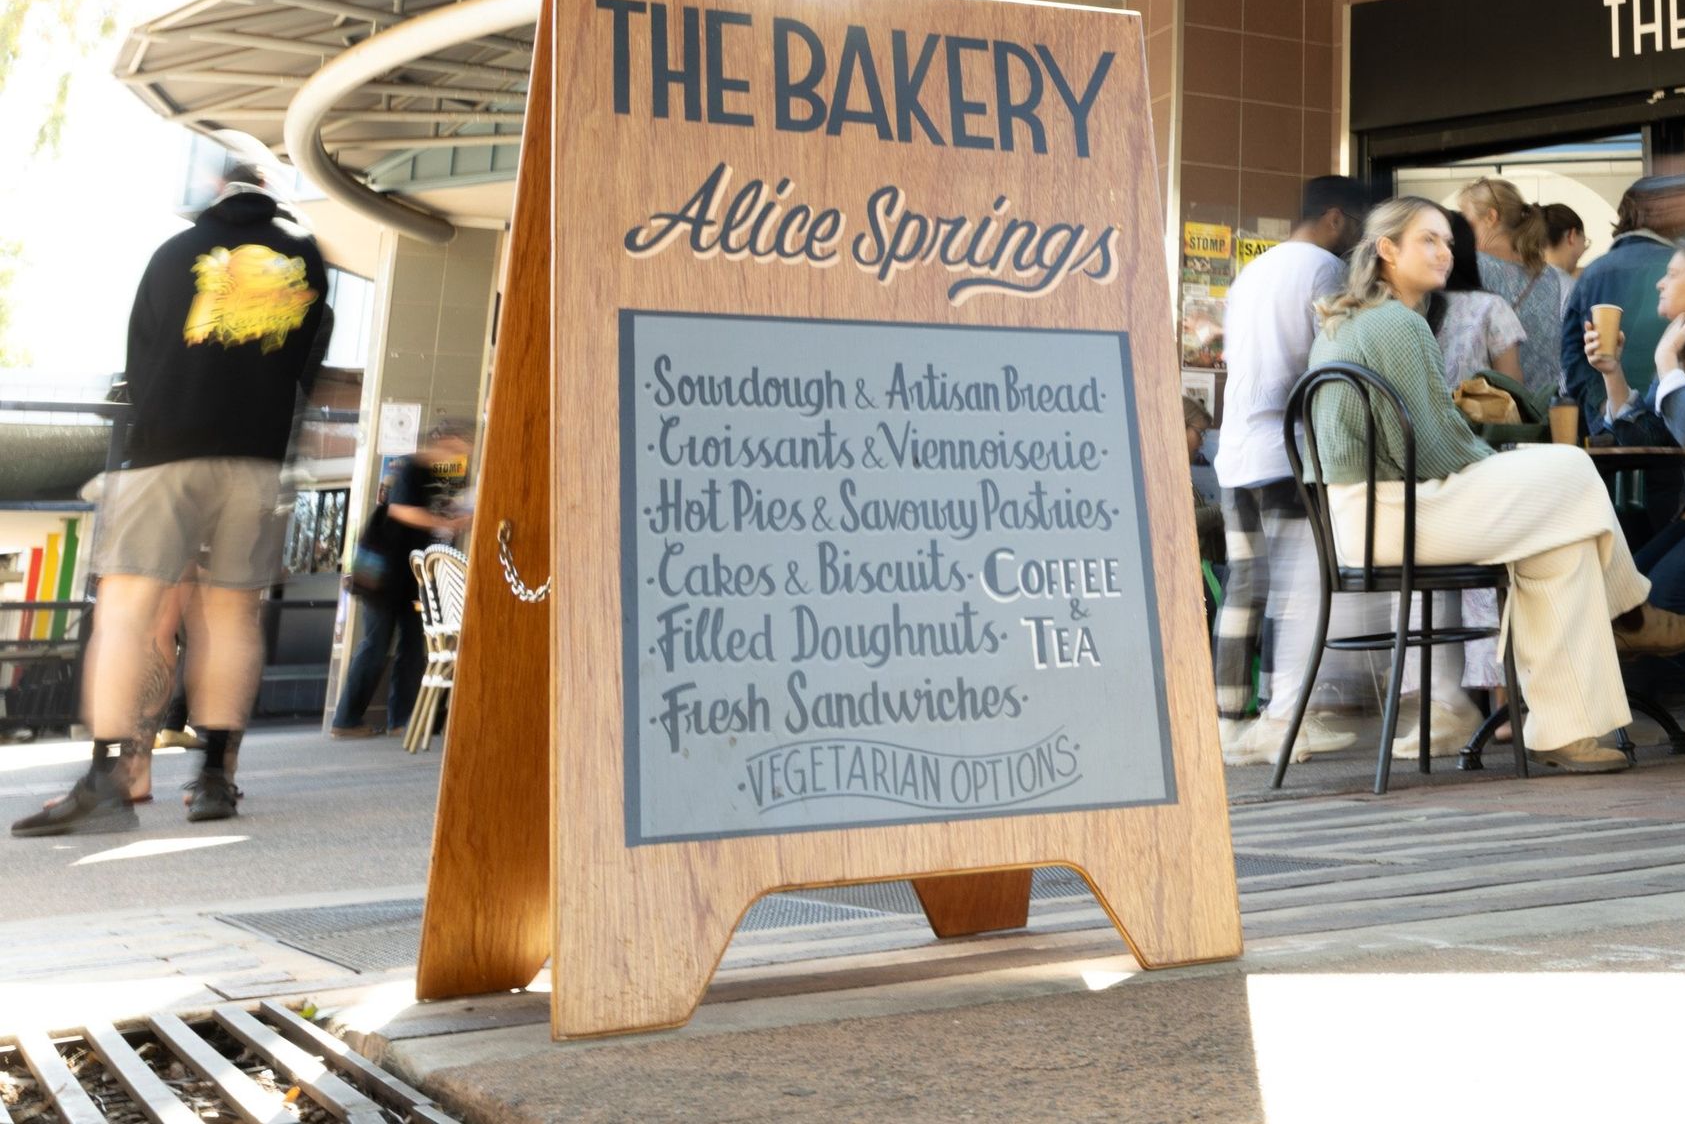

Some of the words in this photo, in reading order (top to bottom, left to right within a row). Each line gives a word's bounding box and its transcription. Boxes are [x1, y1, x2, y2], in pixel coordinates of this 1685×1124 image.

[772, 17, 1116, 158] BAKERY
[625, 162, 845, 268] Alice
[852, 185, 1121, 307] Springs
[1189, 236, 1225, 252] STOMP
[653, 353, 847, 417] Sourdough
[856, 377, 878, 408] &
[885, 362, 1001, 414] Artisan
[1001, 365, 1104, 414] Bread
[659, 413, 855, 472] Croissants
[861, 435, 884, 467] &
[878, 421, 1102, 472] Viennoiserie
[648, 477, 729, 534] Hot
[731, 478, 807, 534] Pies
[812, 497, 836, 531] &
[839, 478, 978, 540] Savoury
[979, 478, 1113, 532] Pastries
[658, 538, 776, 598] Cakes
[785, 560, 809, 593] &
[817, 540, 967, 597] Biscuits
[979, 547, 1122, 603] COFFEE
[657, 601, 777, 672] Filled
[791, 601, 1000, 669] Doughnuts
[1069, 597, 1091, 620] &
[1021, 616, 1101, 671] TEA
[660, 681, 771, 753] Fresh
[785, 670, 1022, 735] Sandwiches
[745, 743, 942, 807] VEGETARIAN
[951, 734, 1078, 804] OPTIONS
